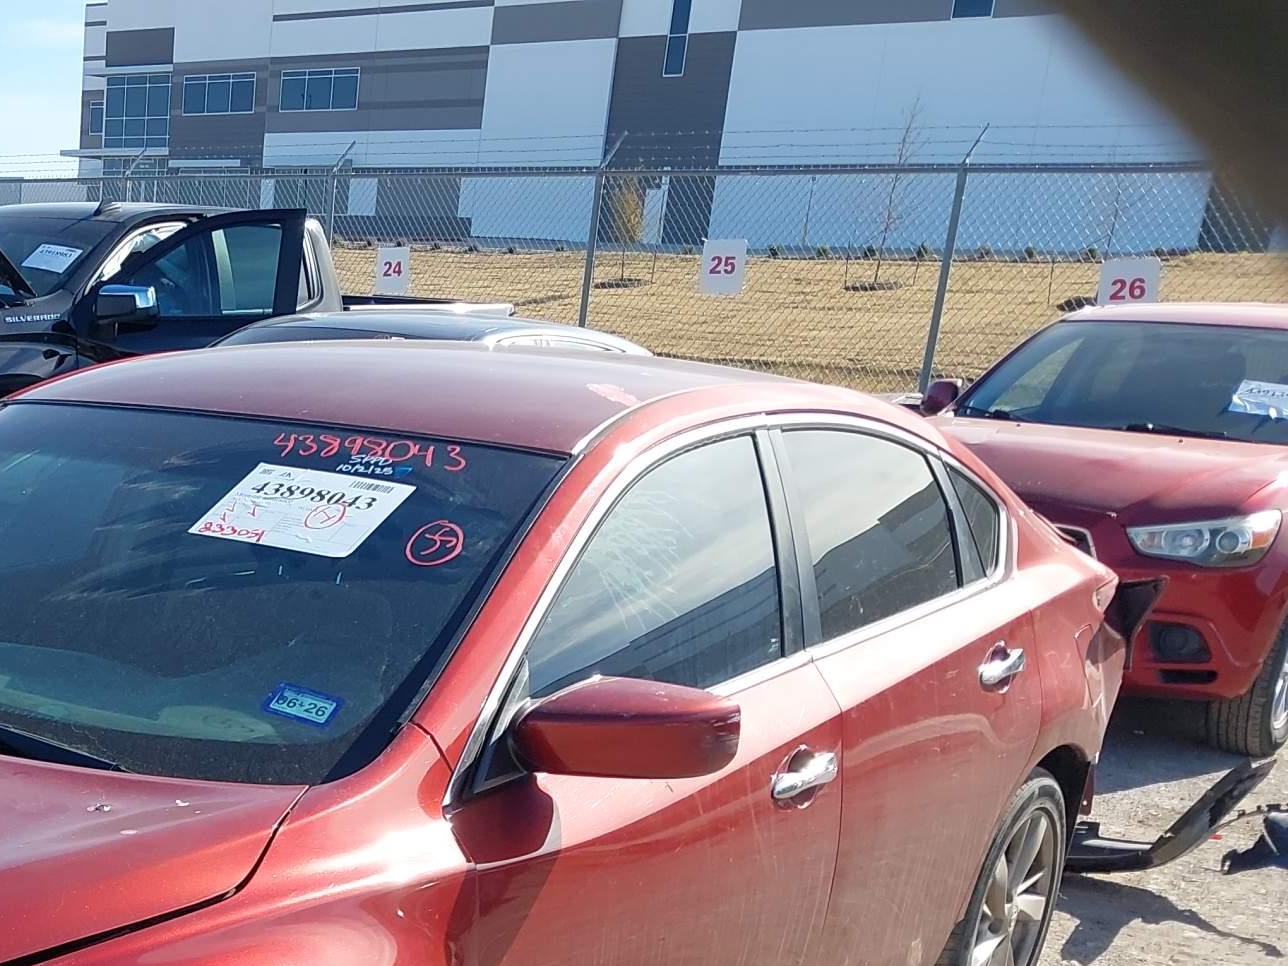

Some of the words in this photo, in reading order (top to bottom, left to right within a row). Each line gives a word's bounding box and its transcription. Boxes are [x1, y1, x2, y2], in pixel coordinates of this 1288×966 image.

[382, 260, 403, 277] 24
[708, 255, 737, 275] 25
[1109, 277, 1147, 300] 26
[5, 313, 61, 323] SILVERADO
[274, 432, 467, 471] 43898043
[251, 480, 378, 512] 43898043
